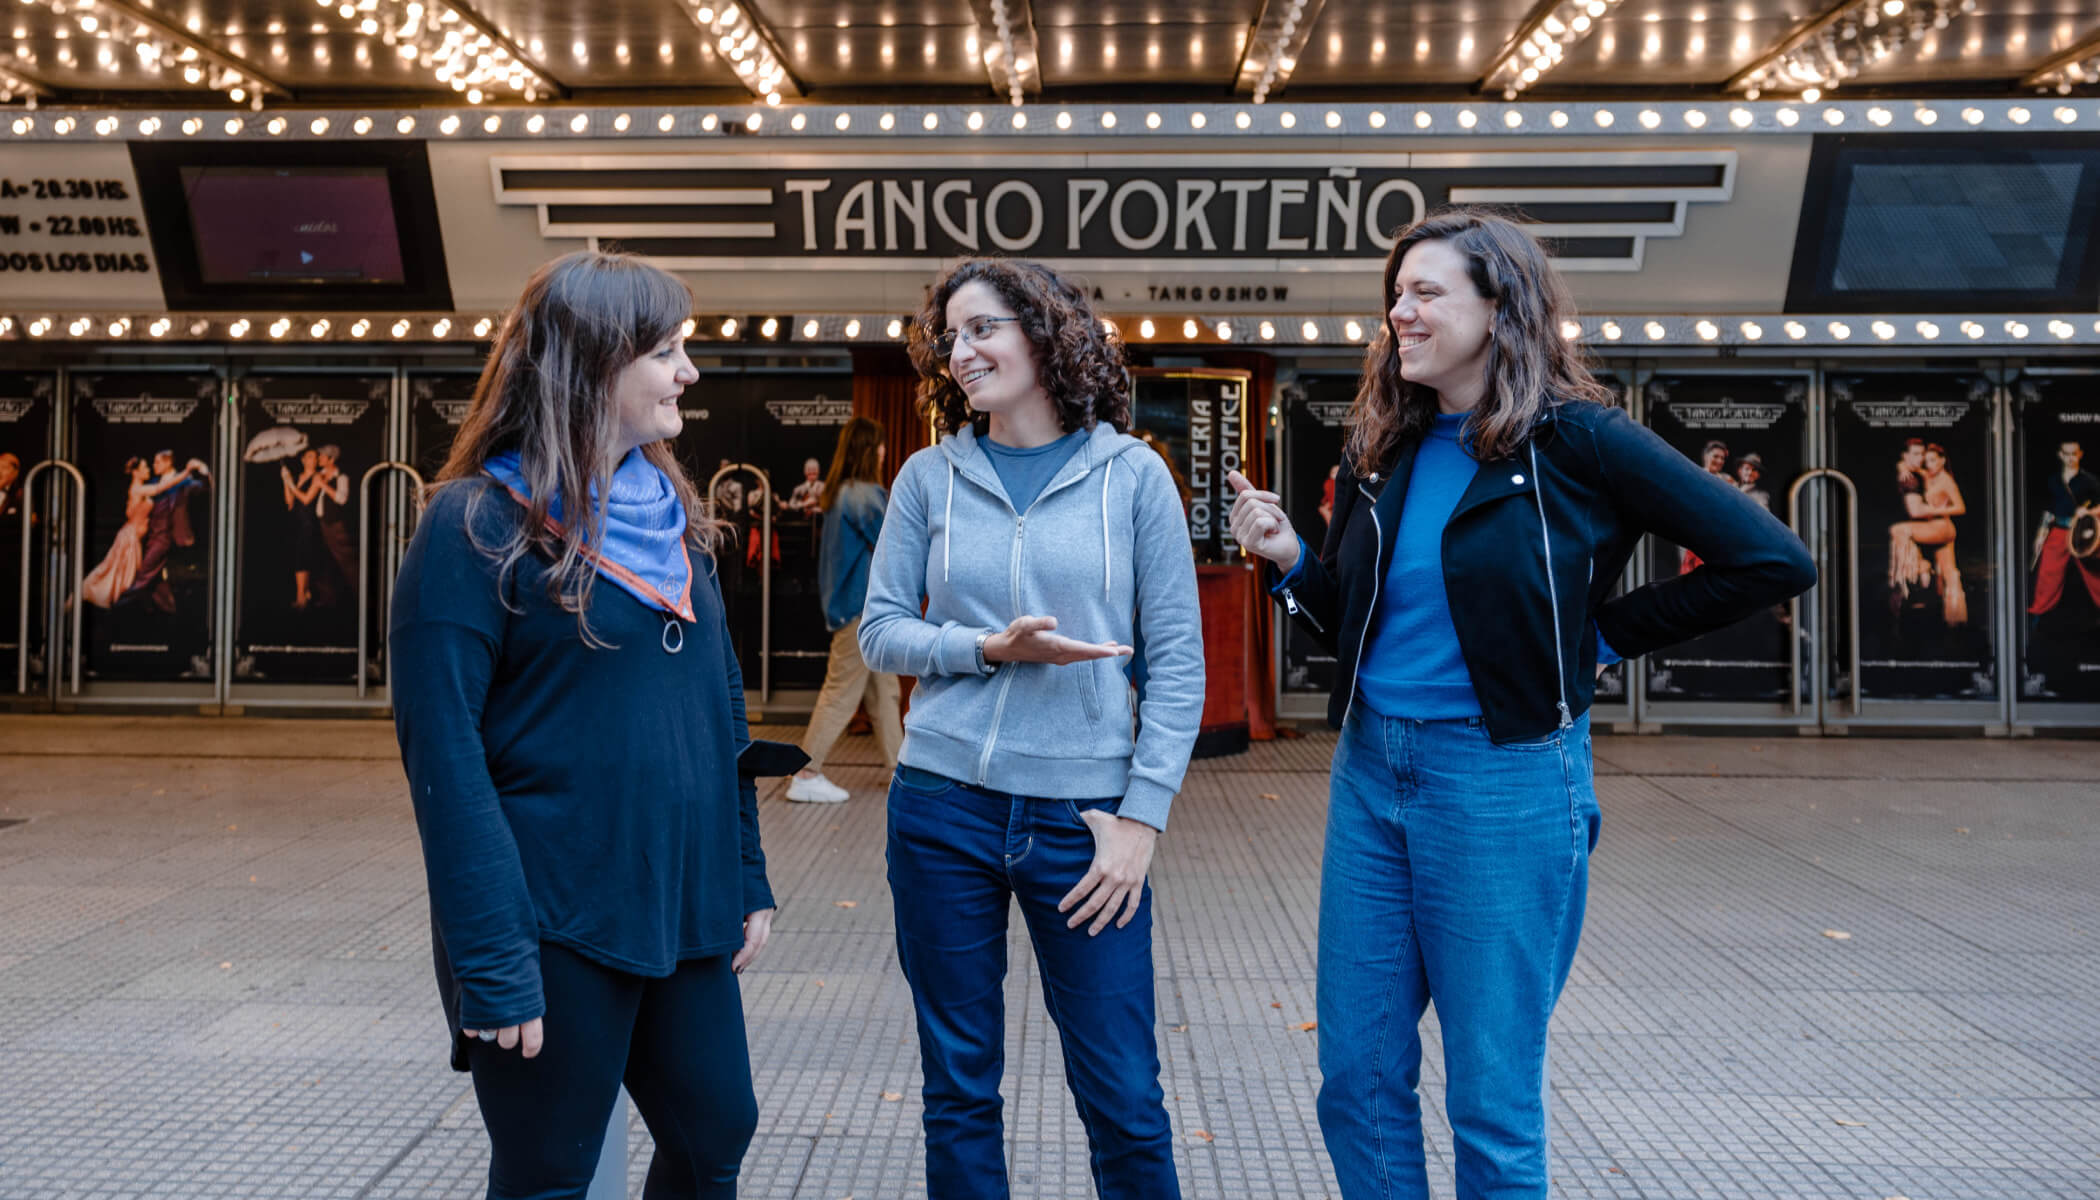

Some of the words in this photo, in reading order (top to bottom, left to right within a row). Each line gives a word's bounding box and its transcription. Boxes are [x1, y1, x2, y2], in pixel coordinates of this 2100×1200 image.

[785, 178, 1043, 252] TANGO
[1067, 166, 1425, 252] PORTEÑO
[45, 252, 92, 273] LOS
[94, 253, 150, 273] DIAS
[1191, 399, 1212, 540] BOLETERIA
